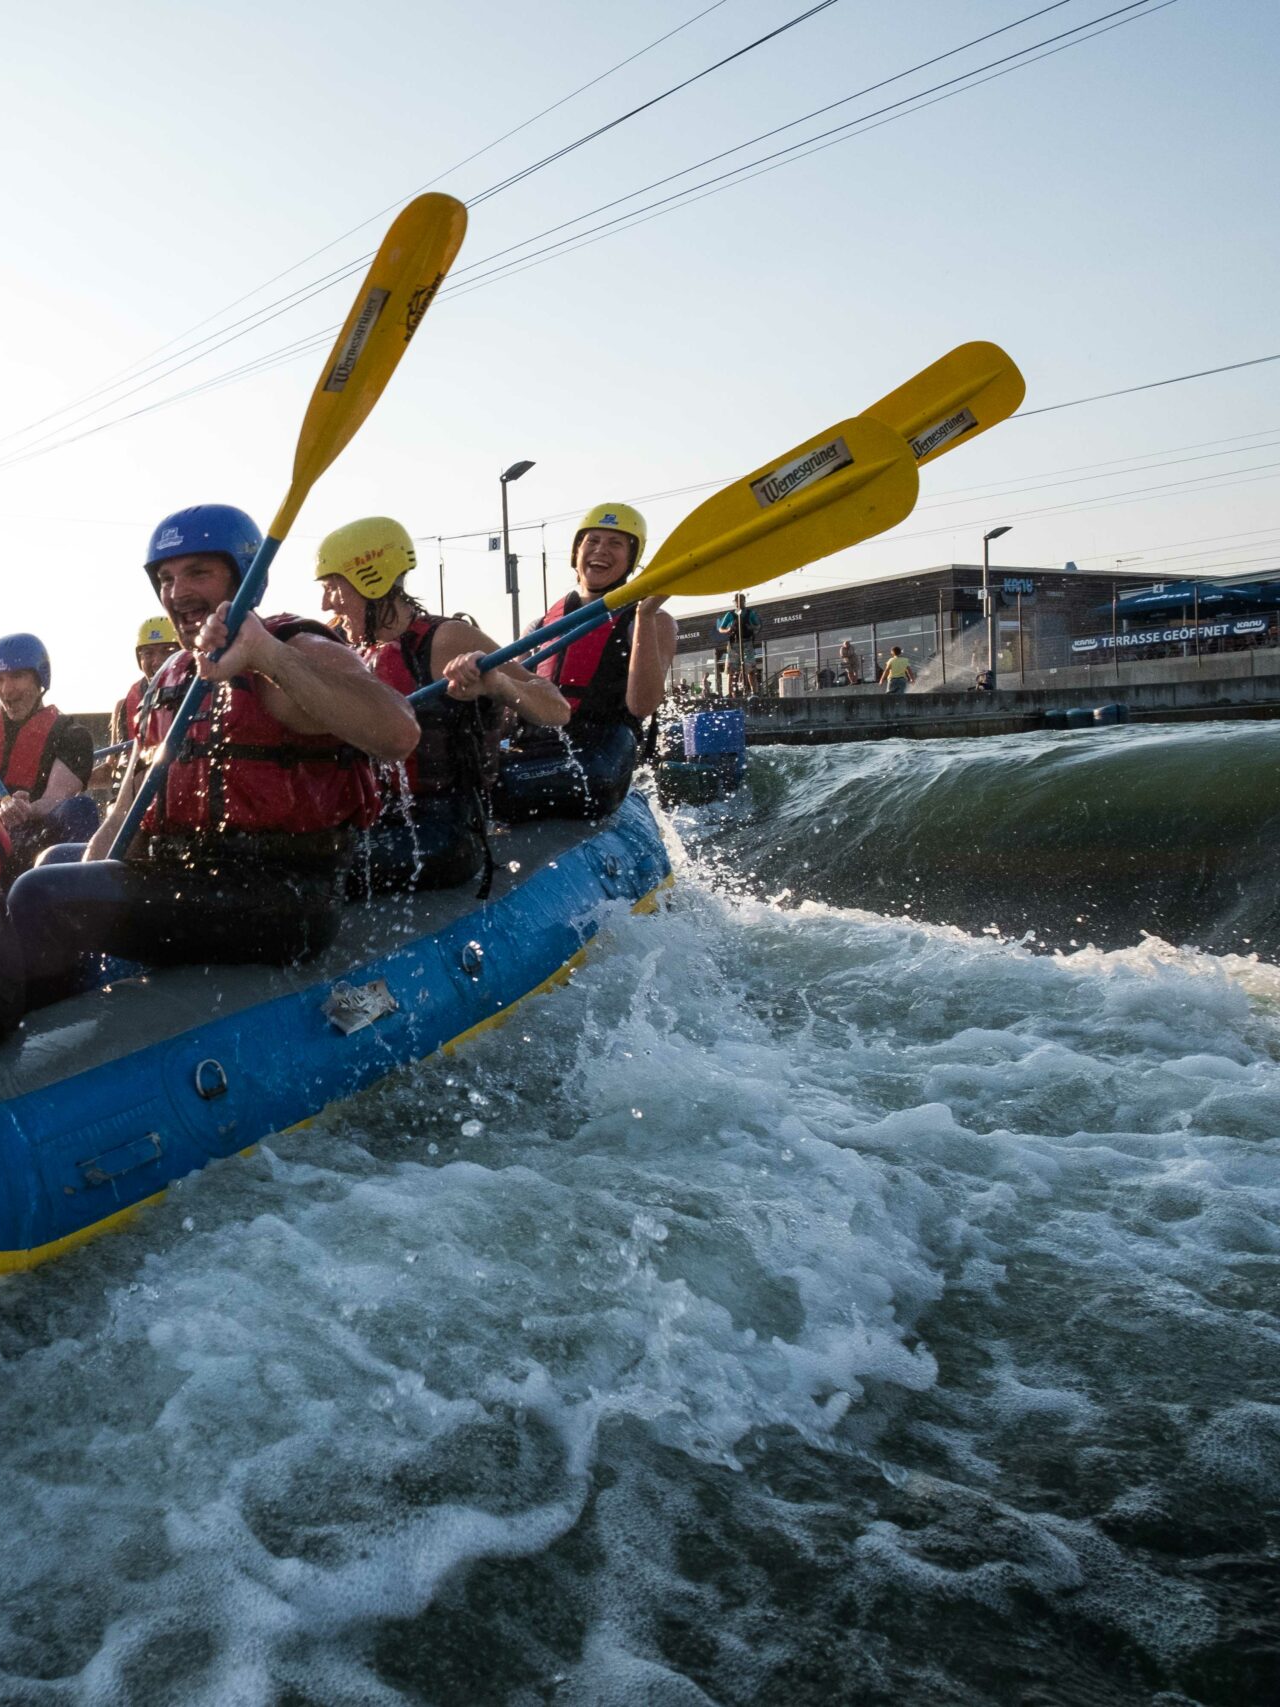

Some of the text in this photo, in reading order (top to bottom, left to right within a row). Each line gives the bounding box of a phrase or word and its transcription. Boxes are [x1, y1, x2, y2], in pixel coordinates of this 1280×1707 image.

[761, 442, 839, 504] Wernesgrüner
[492, 538, 498, 550] 8
[774, 614, 803, 624] TERRASSE
[1102, 632, 1160, 648] TERRASSE
[1163, 623, 1230, 642] GEÖFFNET
